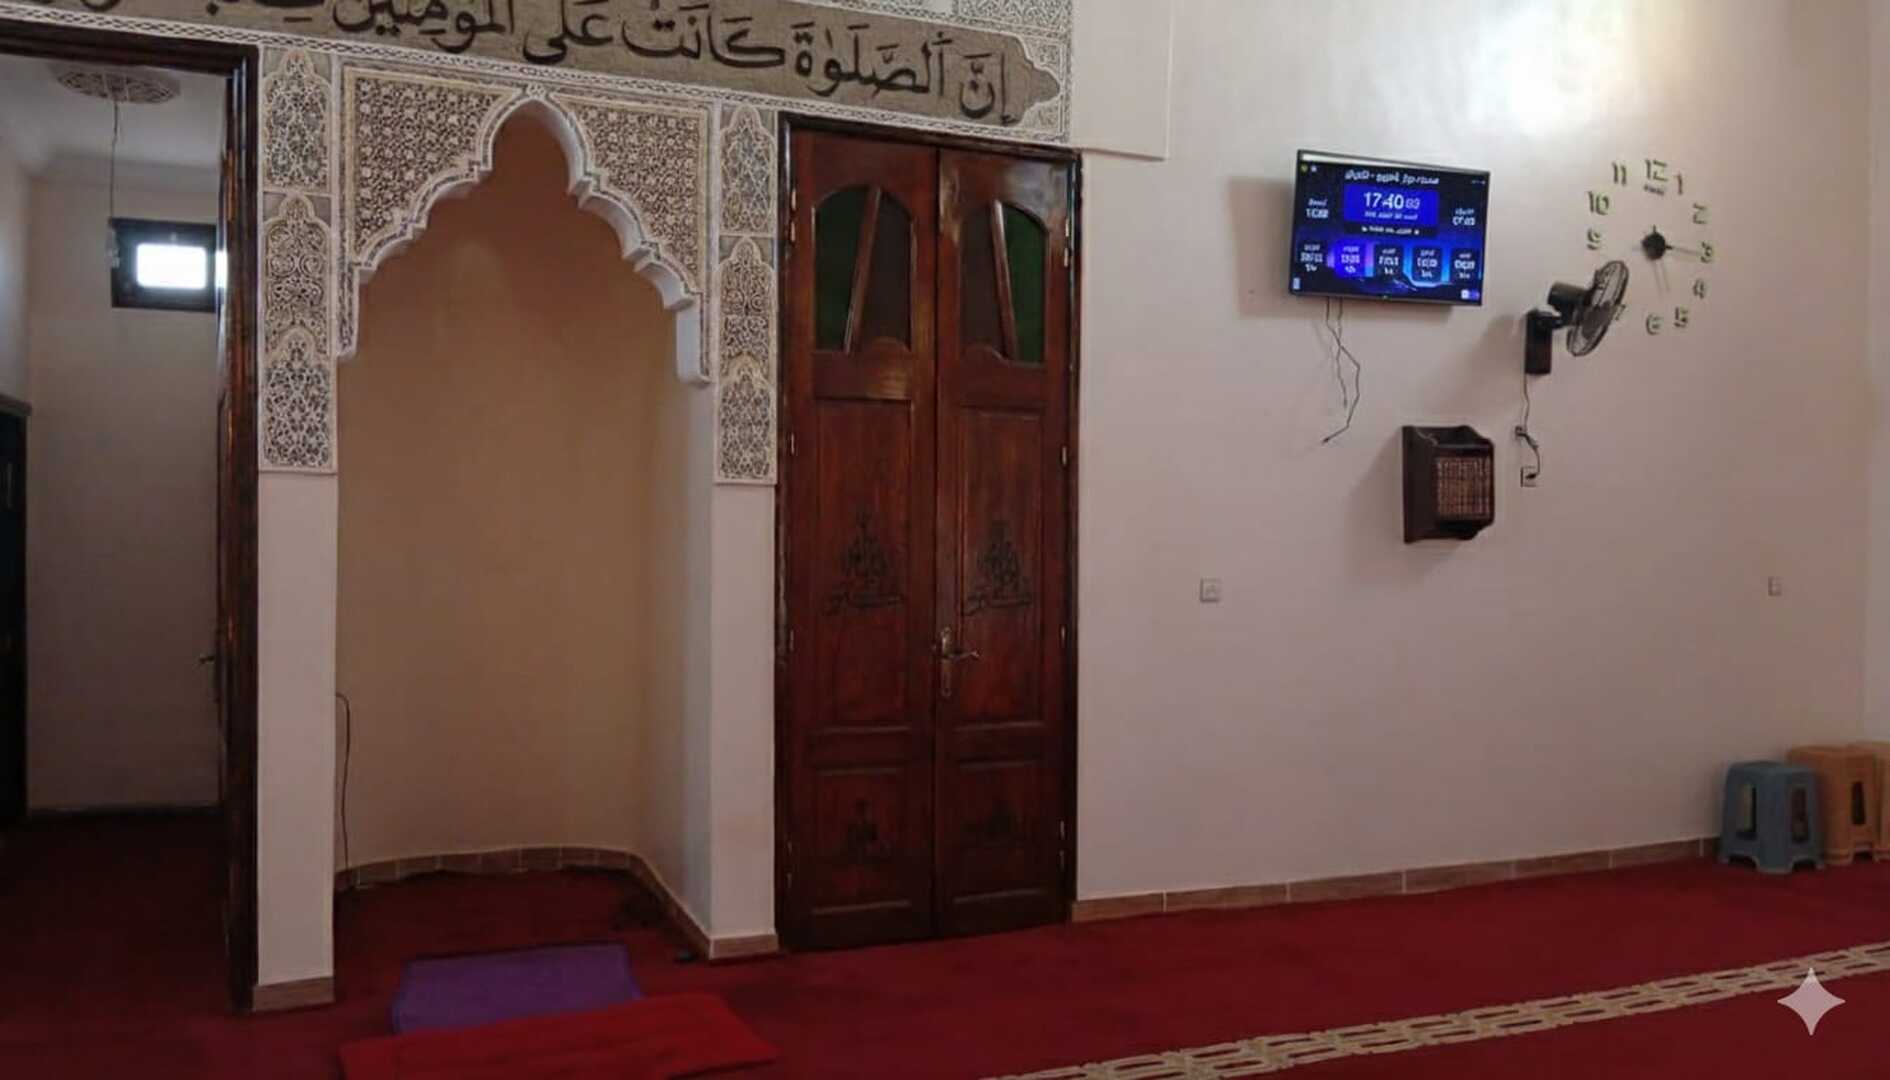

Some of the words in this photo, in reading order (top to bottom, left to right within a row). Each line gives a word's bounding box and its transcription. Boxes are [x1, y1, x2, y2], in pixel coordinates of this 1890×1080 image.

[1613, 162, 1627, 186] 11
[1644, 159, 1668, 182] 12
[1676, 172, 1683, 196] 1
[1588, 191, 1610, 216] 10
